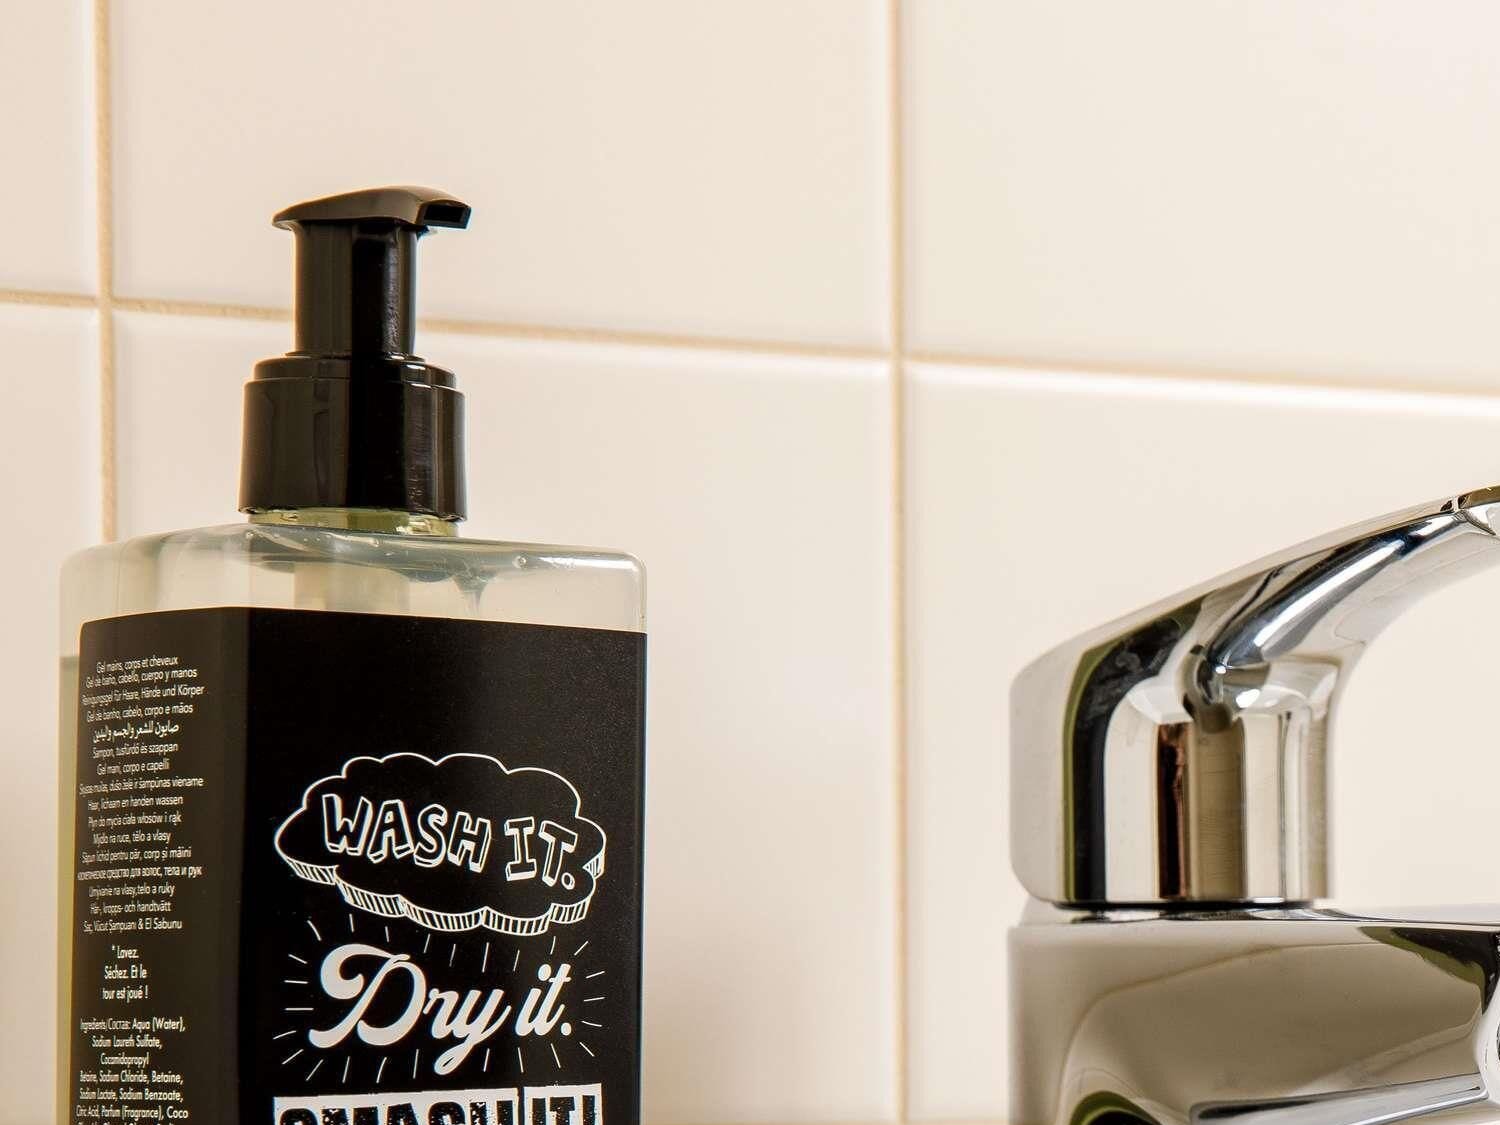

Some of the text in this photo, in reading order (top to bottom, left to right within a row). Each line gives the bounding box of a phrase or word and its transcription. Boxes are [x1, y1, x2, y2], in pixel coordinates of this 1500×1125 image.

[171, 669, 198, 678] manos
[162, 685, 176, 697] und
[178, 683, 205, 698] Körper
[156, 796, 183, 805] wassen
[322, 794, 578, 890] WASH IT.
[153, 917, 183, 929] Sabunu
[139, 963, 148, 979] le
[102, 987, 115, 1000] tour
[116, 987, 126, 999] est
[308, 943, 572, 1076] Dry it.
[132, 1018, 150, 1033] Aqua
[151, 1070, 184, 1085] Betaine,
[119, 1087, 143, 1099] Sodium
[144, 1088, 184, 1102] Benzoate,
[166, 1106, 189, 1119] Coco
